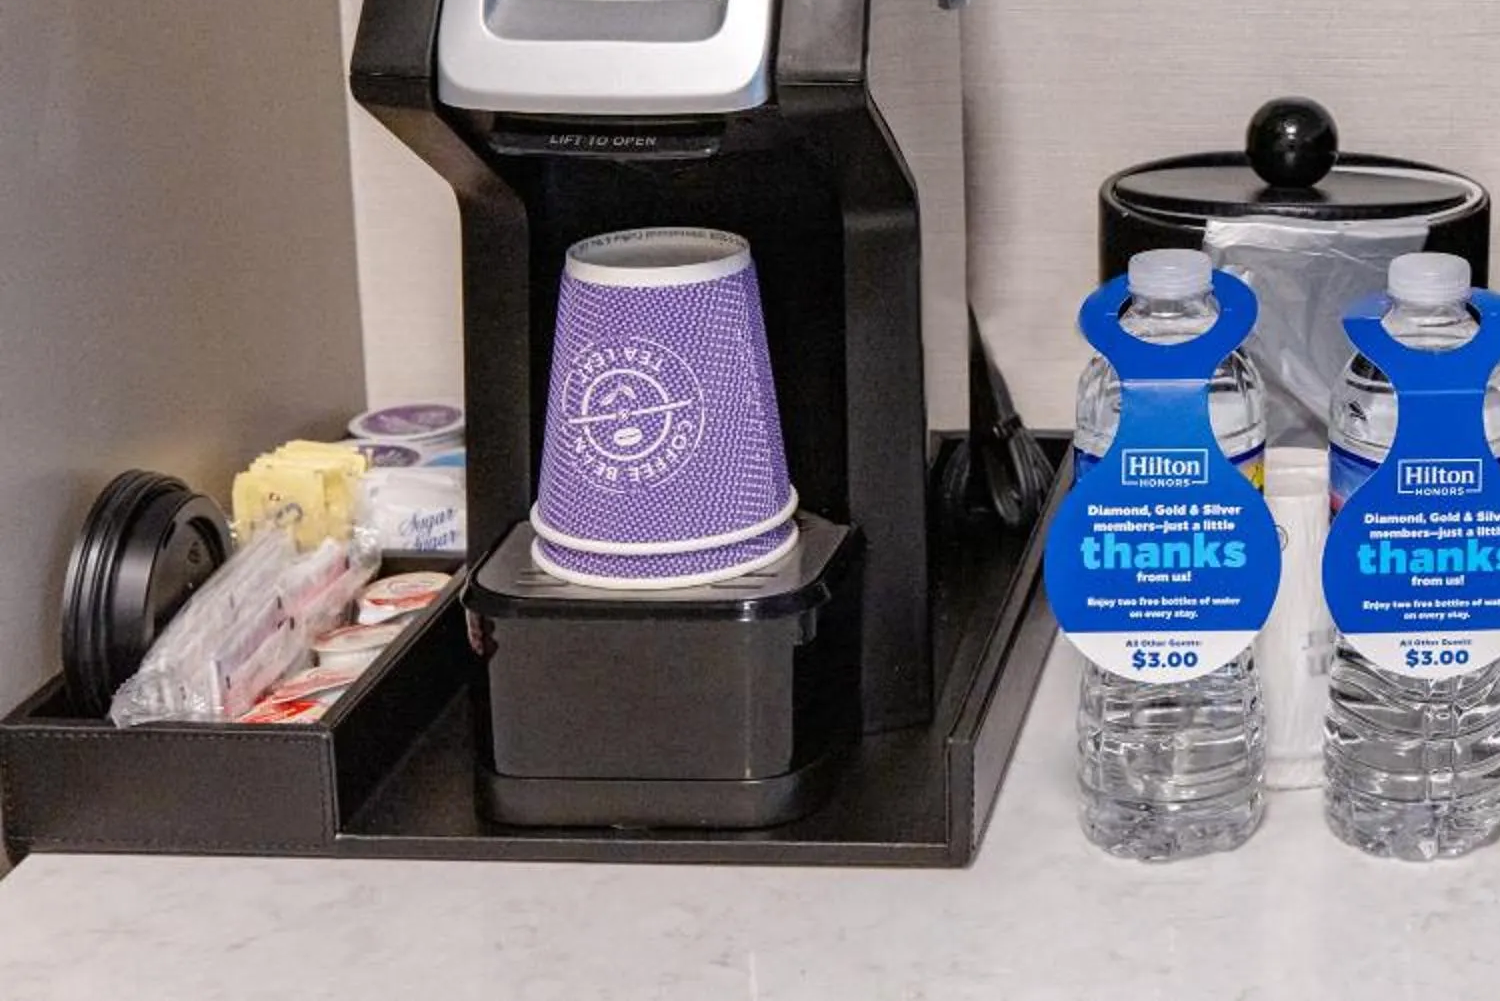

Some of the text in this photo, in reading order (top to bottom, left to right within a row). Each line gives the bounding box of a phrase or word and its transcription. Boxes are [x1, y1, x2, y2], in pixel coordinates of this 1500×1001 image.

[550, 135, 657, 147] LIFT TO OPEN
[624, 348, 664, 372] TEA
[628, 420, 692, 481] COFFEE
[1128, 456, 1201, 477] Hilton
[1404, 466, 1475, 486] Hilton
[1138, 479, 1191, 488] HONORS
[1415, 487, 1465, 497] HONORS
[1087, 503, 1242, 517] Diamond, Gold & Silver
[1364, 512, 1427, 525] Diamond,
[1429, 511, 1461, 524] Gold
[1463, 512, 1473, 523] &
[1192, 523, 1201, 531] a
[1203, 520, 1236, 531] little
[1466, 529, 1475, 537] a
[1080, 532, 1248, 570] thanks
[1136, 570, 1193, 583] from us!
[1411, 574, 1466, 587] from us!
[1087, 598, 1116, 608] Enjoy
[1139, 597, 1159, 606] free
[1161, 597, 1197, 606] bottles
[1199, 597, 1210, 606] of
[1212, 598, 1241, 606] water
[1362, 601, 1391, 611] Enjoy
[1413, 600, 1433, 609] free
[1435, 599, 1471, 608] bottles
[1472, 598, 1483, 607] of
[1129, 610, 1199, 619] on every stay.
[1417, 612, 1445, 621] every
[1447, 611, 1471, 620] stay.
[1132, 649, 1198, 671] $3.00
[1405, 649, 1469, 668] $3.00
